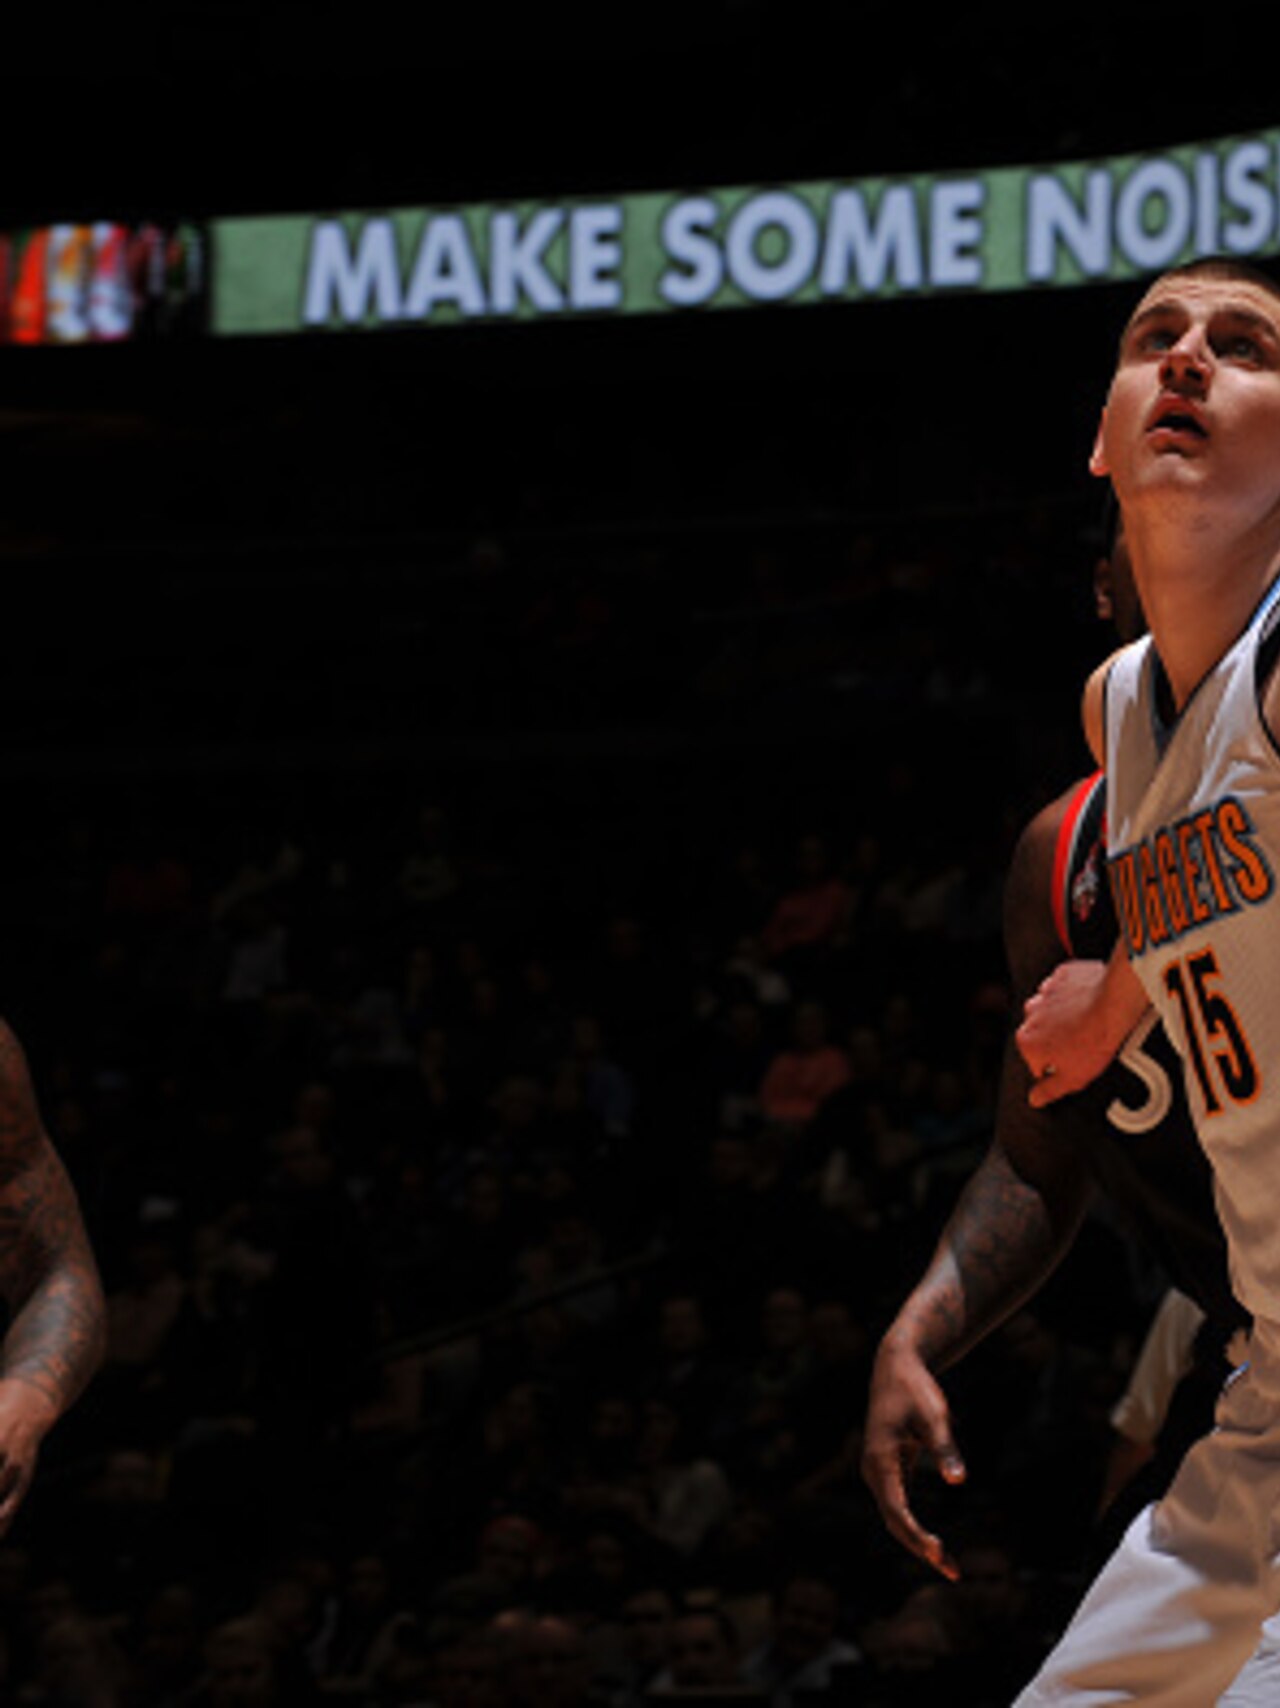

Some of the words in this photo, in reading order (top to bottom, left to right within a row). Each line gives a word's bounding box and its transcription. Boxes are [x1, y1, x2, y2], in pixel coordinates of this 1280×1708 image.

[304, 208, 622, 324] MAKE
[660, 179, 983, 306] SOME
[1108, 797, 1274, 957] UGGETS
[1163, 947, 1261, 1116] 15
